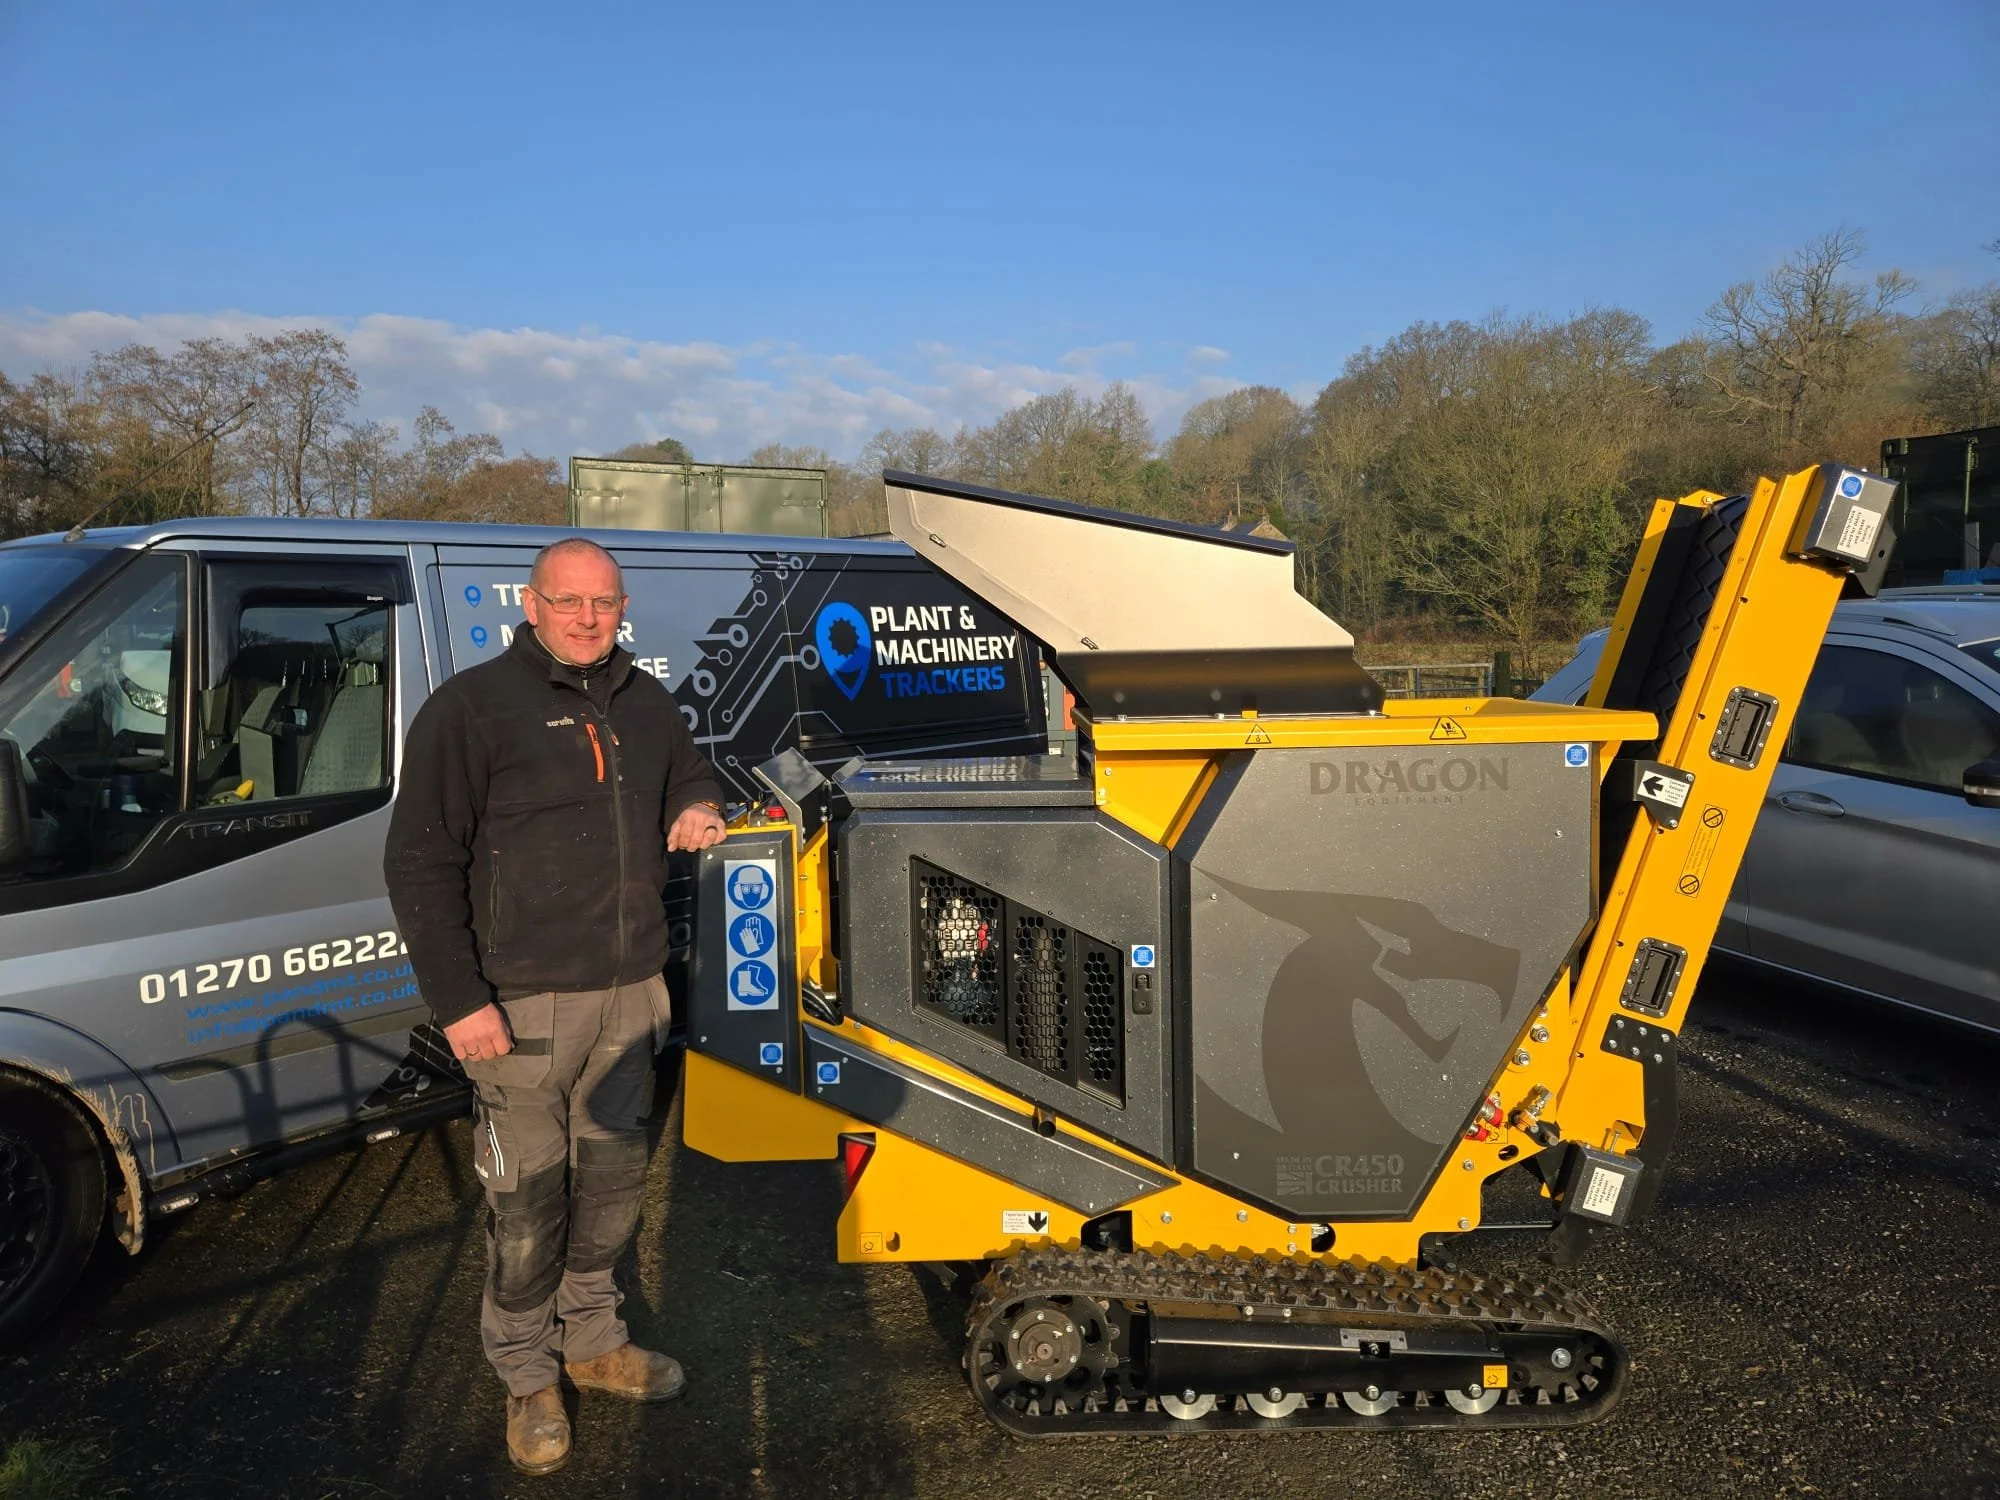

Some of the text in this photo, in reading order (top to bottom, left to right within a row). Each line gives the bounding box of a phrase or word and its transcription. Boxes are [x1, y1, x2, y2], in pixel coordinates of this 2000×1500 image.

[870, 605, 976, 633] PLANT &
[875, 635, 1016, 666] MACHINERY
[880, 665, 1006, 698] TRACKERS
[1310, 758, 1510, 795] DRAGON
[184, 810, 313, 840] TRANSIT
[139, 931, 408, 1004] 01270 66222
[1315, 1154, 1404, 1177] CR450
[1315, 1178, 1403, 1194] CRUSHER
